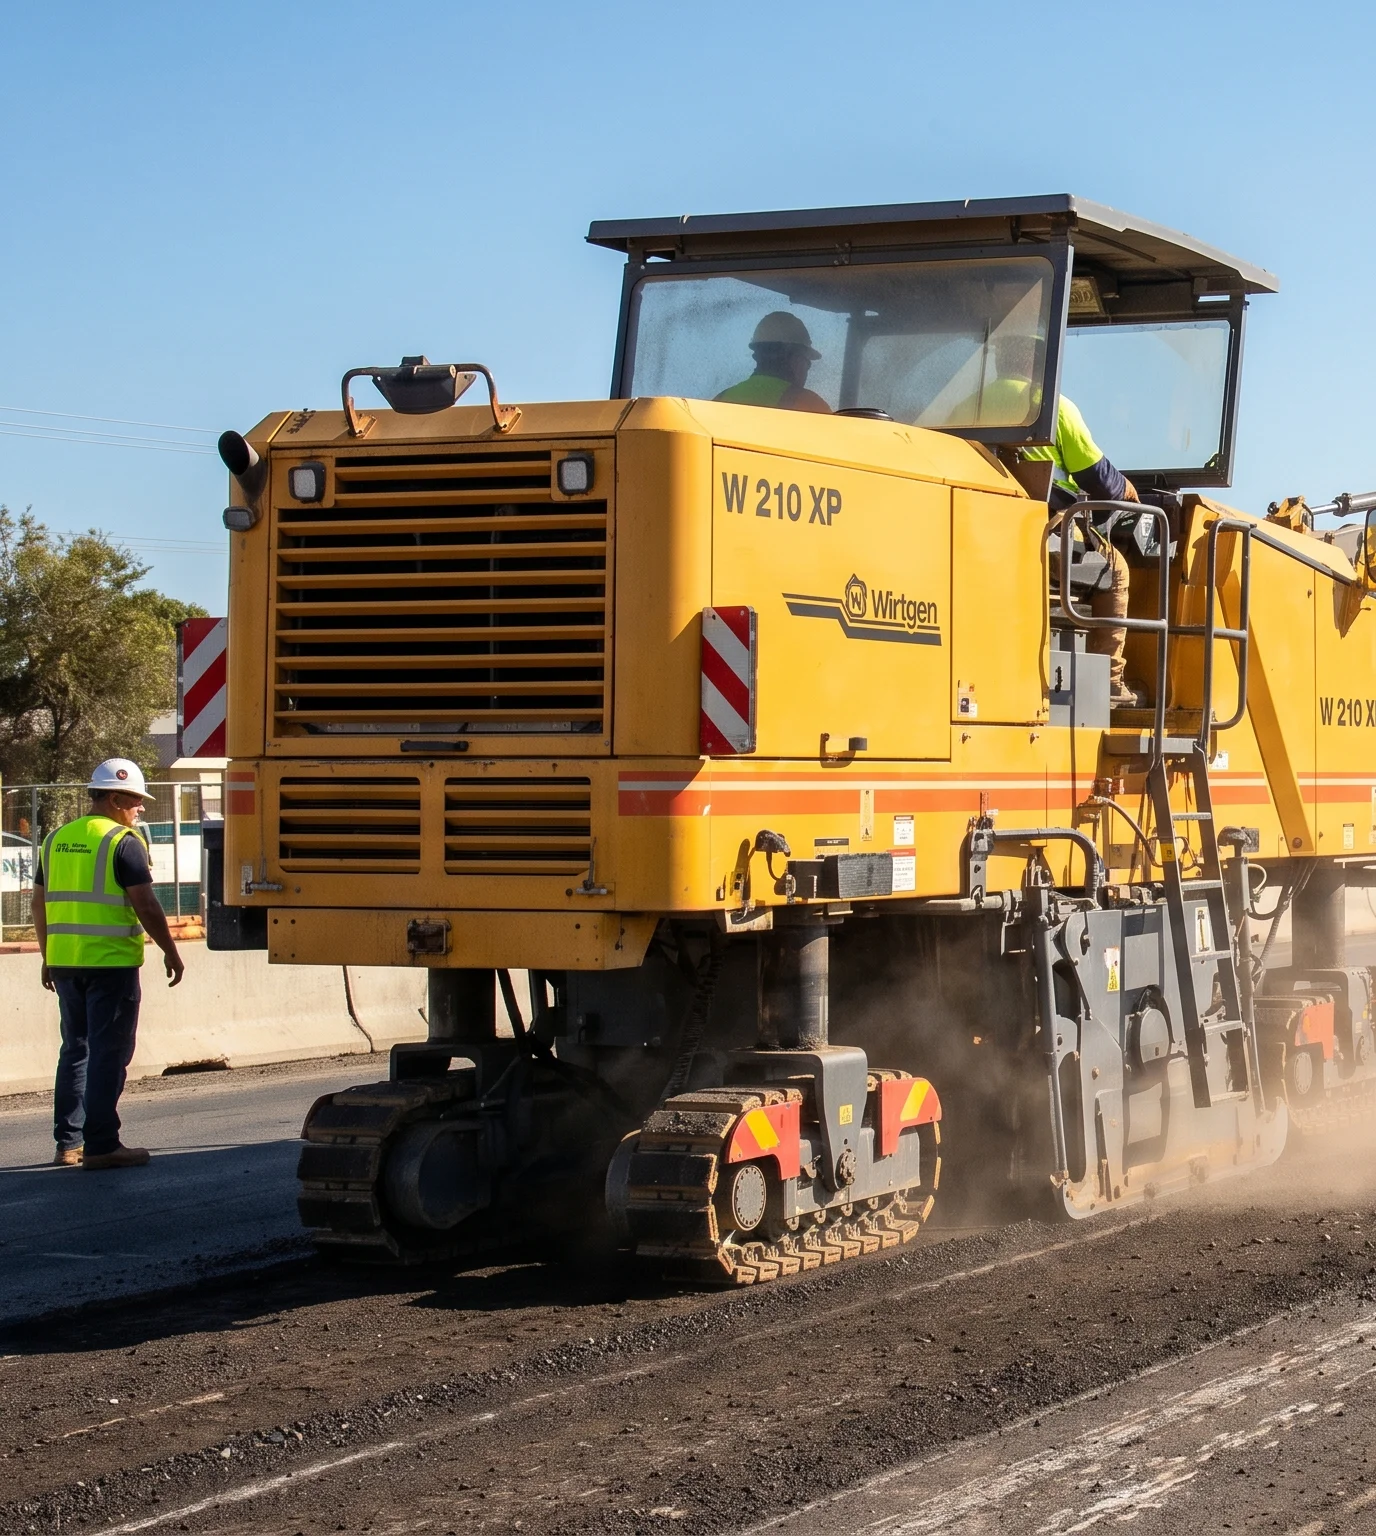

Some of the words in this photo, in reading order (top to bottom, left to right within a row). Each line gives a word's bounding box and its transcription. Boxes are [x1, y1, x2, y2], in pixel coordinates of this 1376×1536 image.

[722, 472, 748, 514] W
[755, 478, 801, 522] 210
[808, 485, 842, 526] XP
[871, 589, 938, 629] Wirtgen
[1320, 697, 1334, 726] W
[1337, 698, 1362, 727] 210
